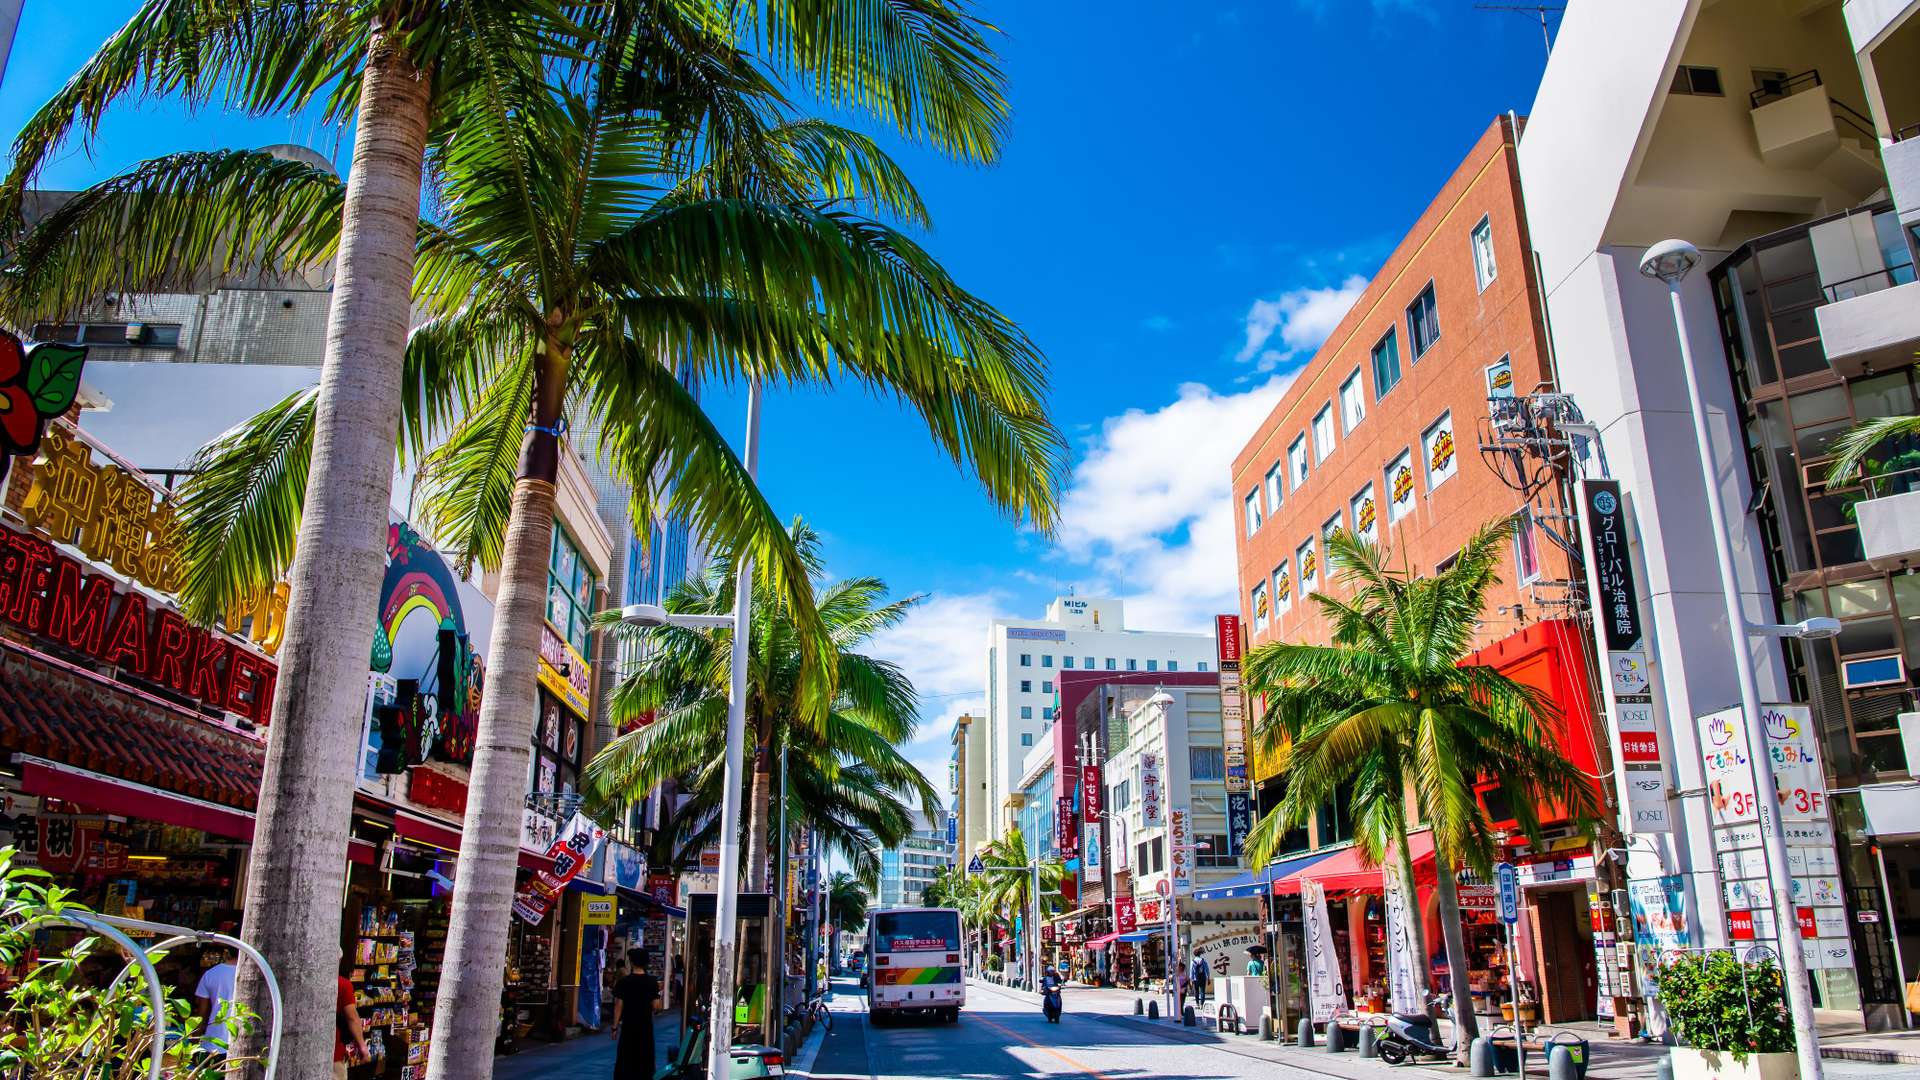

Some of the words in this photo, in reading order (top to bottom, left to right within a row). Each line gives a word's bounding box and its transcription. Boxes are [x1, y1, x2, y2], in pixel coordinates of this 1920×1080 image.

[1602, 517, 1632, 634] グローバル治療院
[49, 560, 278, 727] MARKET
[1706, 749, 1745, 770] てもみん
[1733, 792, 1752, 816] 3F
[1794, 788, 1822, 813] 3F
